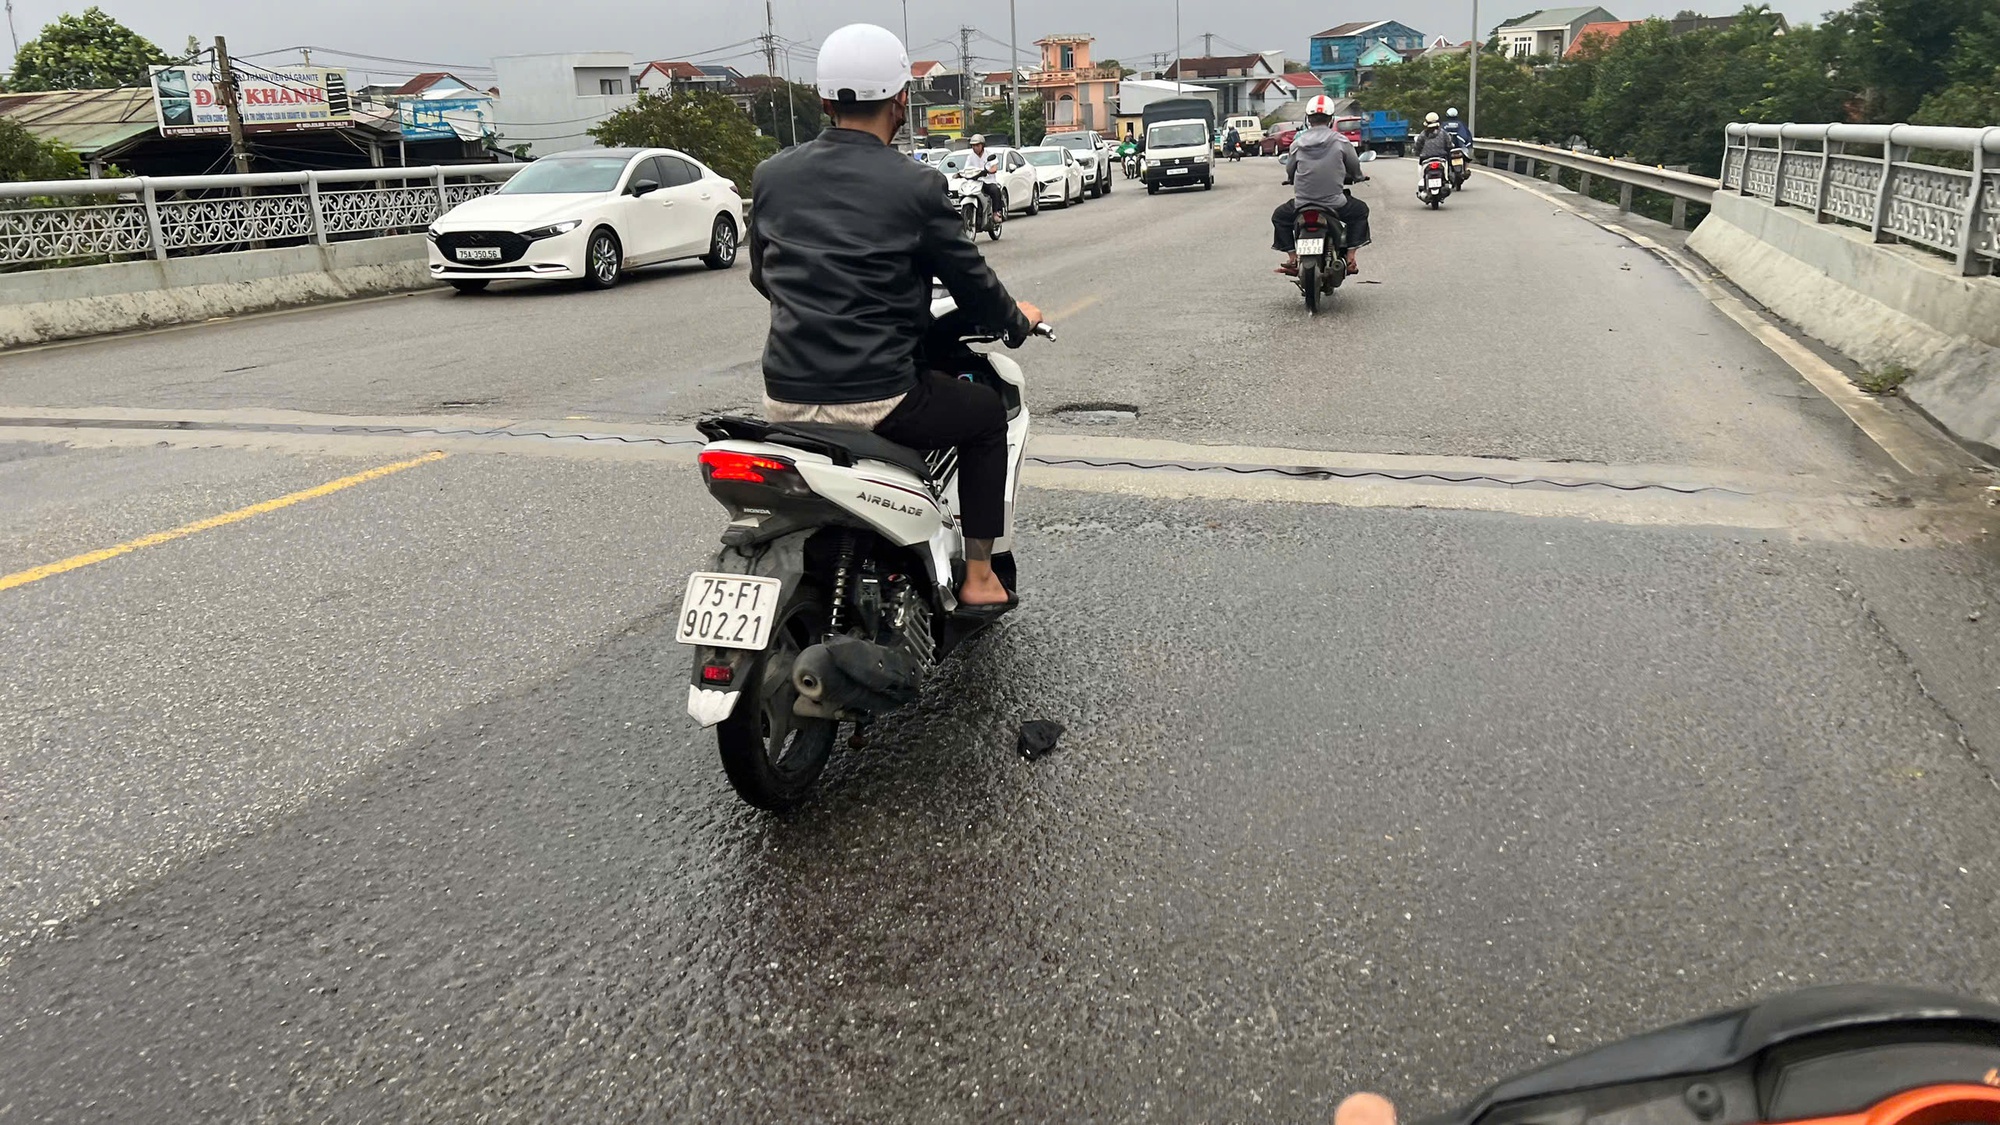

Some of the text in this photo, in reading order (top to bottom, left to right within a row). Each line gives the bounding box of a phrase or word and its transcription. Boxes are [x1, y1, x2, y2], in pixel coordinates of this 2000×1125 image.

[294, 73, 319, 81] GRANITE
[244, 84, 324, 105] KHÁNH
[743, 507, 771, 515] HONDA
[856, 491, 923, 517] AIRBLADE
[698, 579, 762, 611] 75-F1
[683, 609, 762, 644] 902.21
